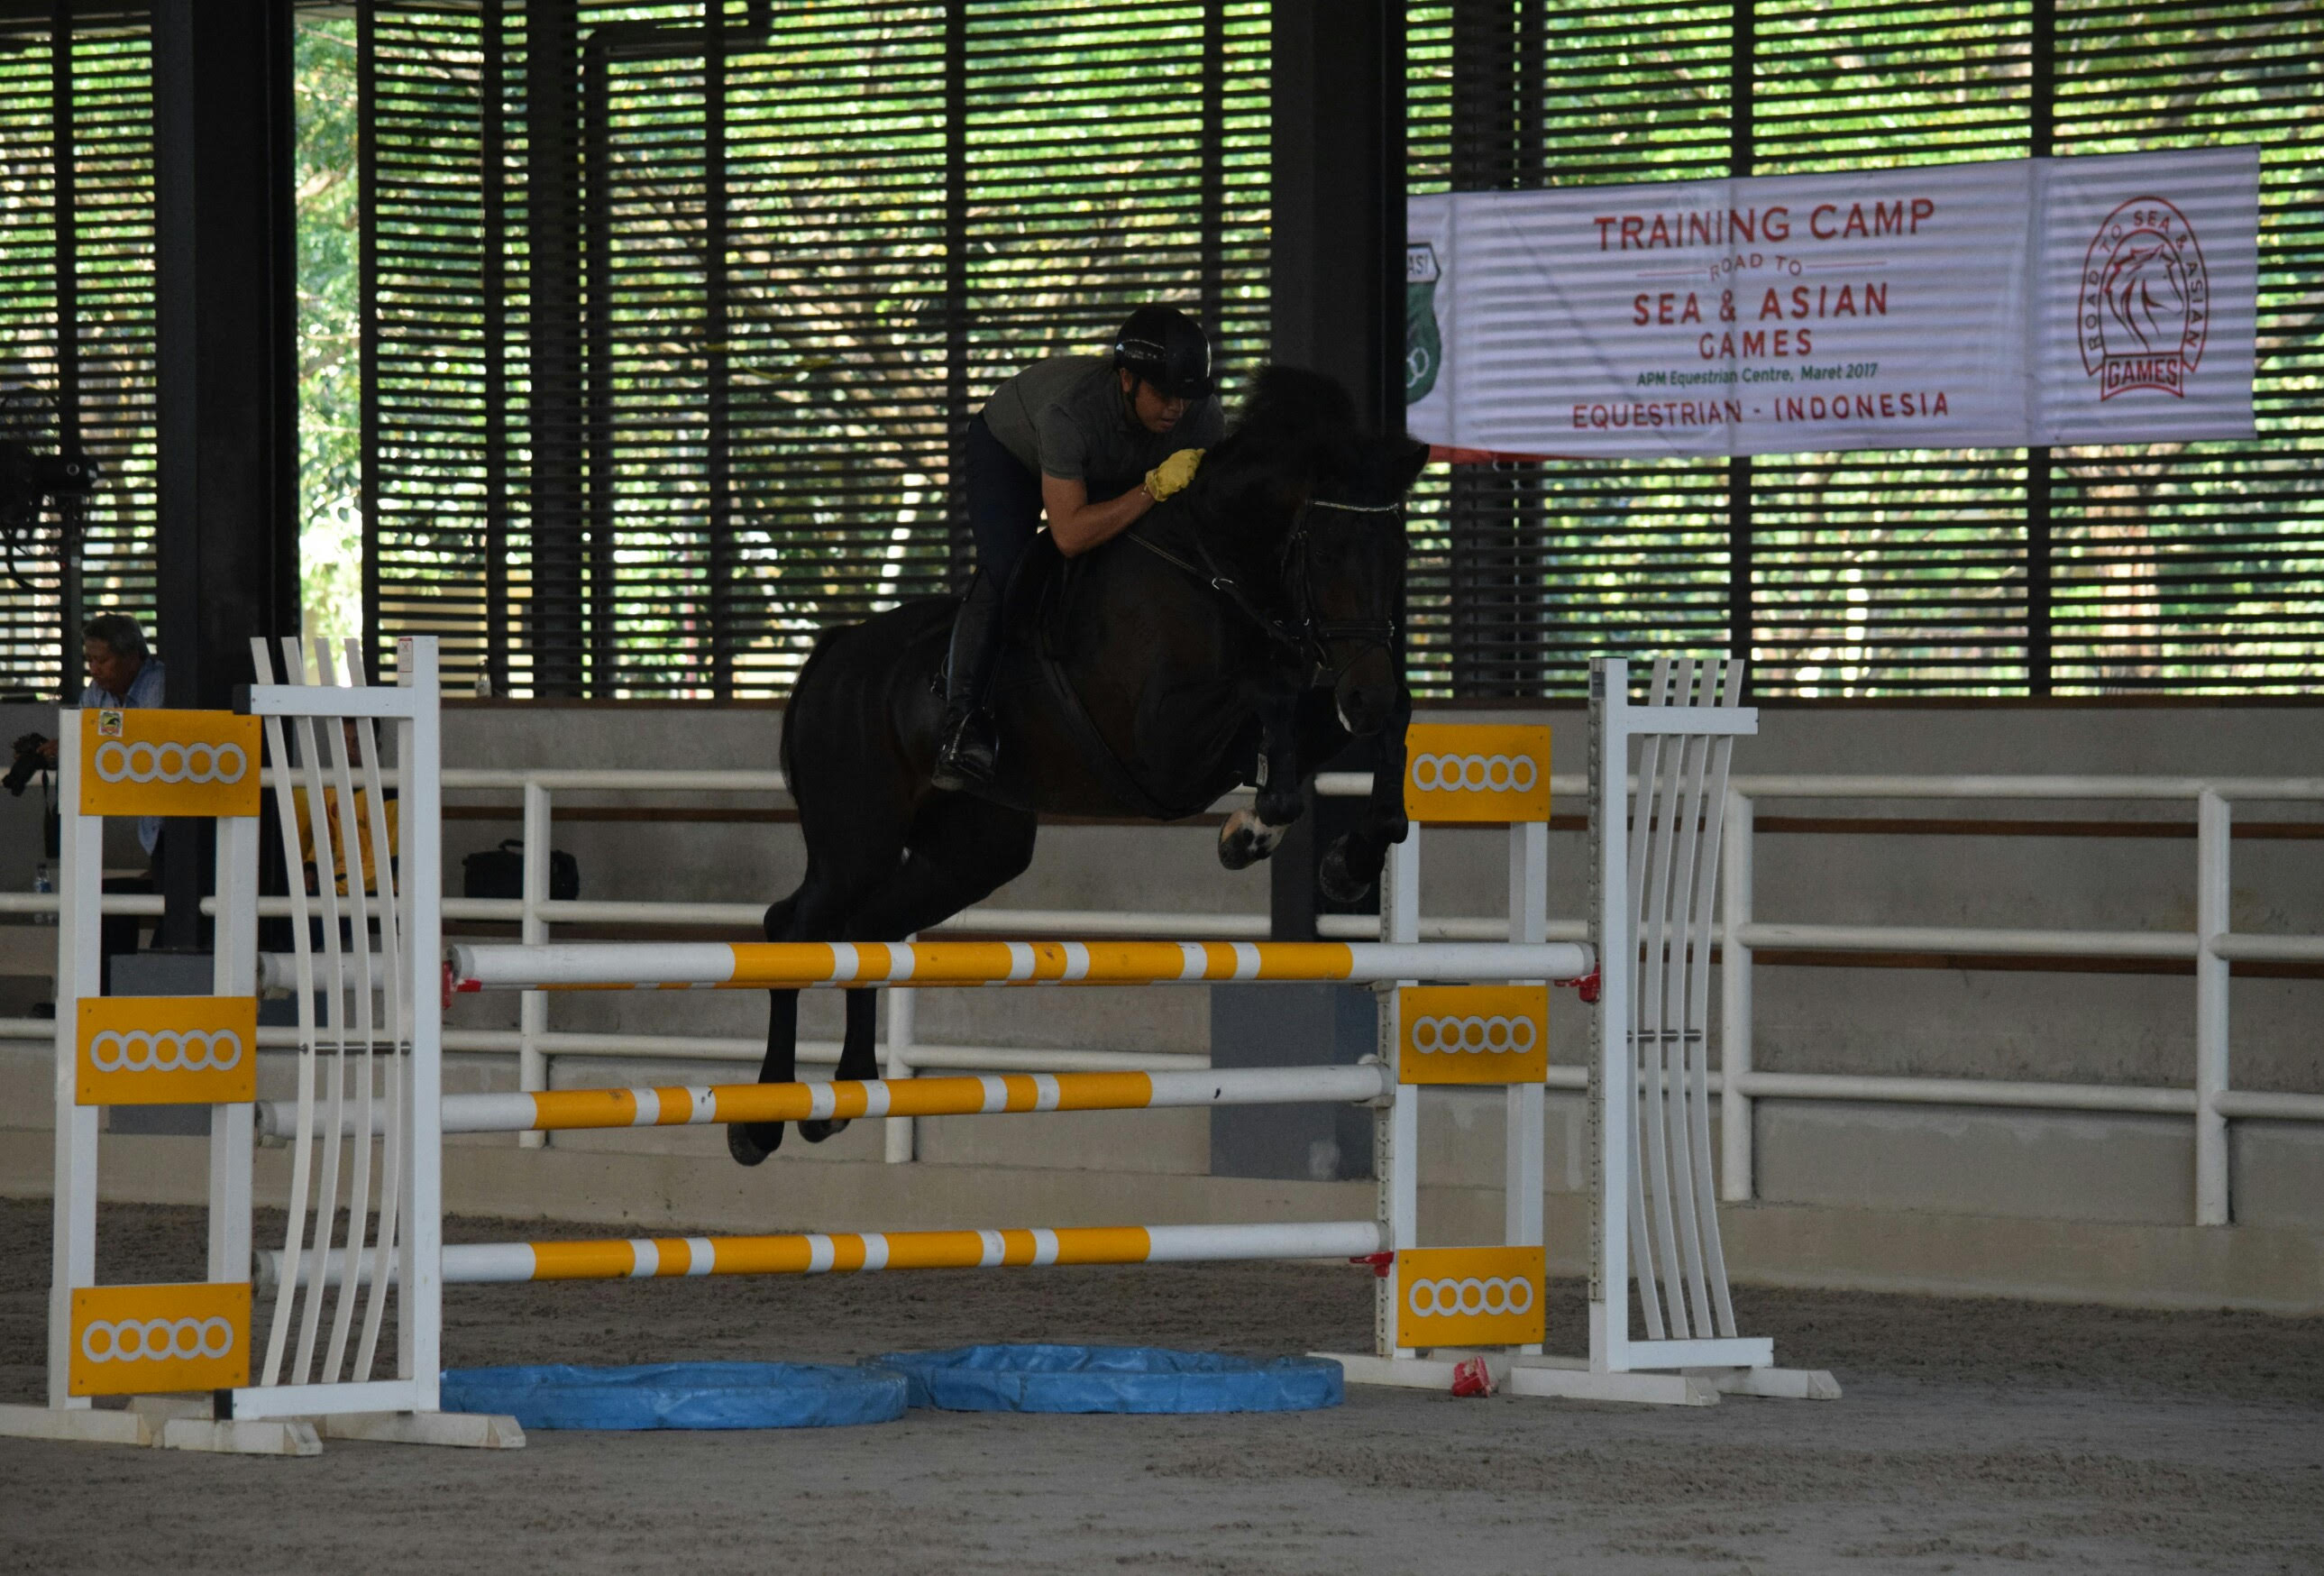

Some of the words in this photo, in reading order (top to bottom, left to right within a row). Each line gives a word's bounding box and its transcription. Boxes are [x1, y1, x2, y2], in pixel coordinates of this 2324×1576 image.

[1594, 206, 1790, 252] TRAINING
[1809, 197, 1935, 241] CAMP
[1709, 252, 1763, 281] ROAD
[1775, 254, 1802, 276] TO
[2084, 270, 2101, 352] ROAD
[2099, 224, 2122, 253] TO
[2133, 209, 2171, 234] SEA
[2185, 261, 2204, 348] ASIAN
[1633, 290, 1702, 326] SEA
[1719, 288, 1736, 322] &
[1759, 281, 1888, 322] ASIAN
[1698, 328, 1812, 360] GAMES
[1636, 371, 1666, 387] APM
[1670, 368, 1737, 389] Equestrian
[1742, 366, 1795, 384] Centre,
[1800, 364, 1843, 380] Maret
[1845, 362, 1879, 380] 2017
[2107, 358, 2179, 389] GAMES
[1572, 399, 1743, 430] EQUESTRIAN
[1774, 391, 1949, 423] INDONESIA
